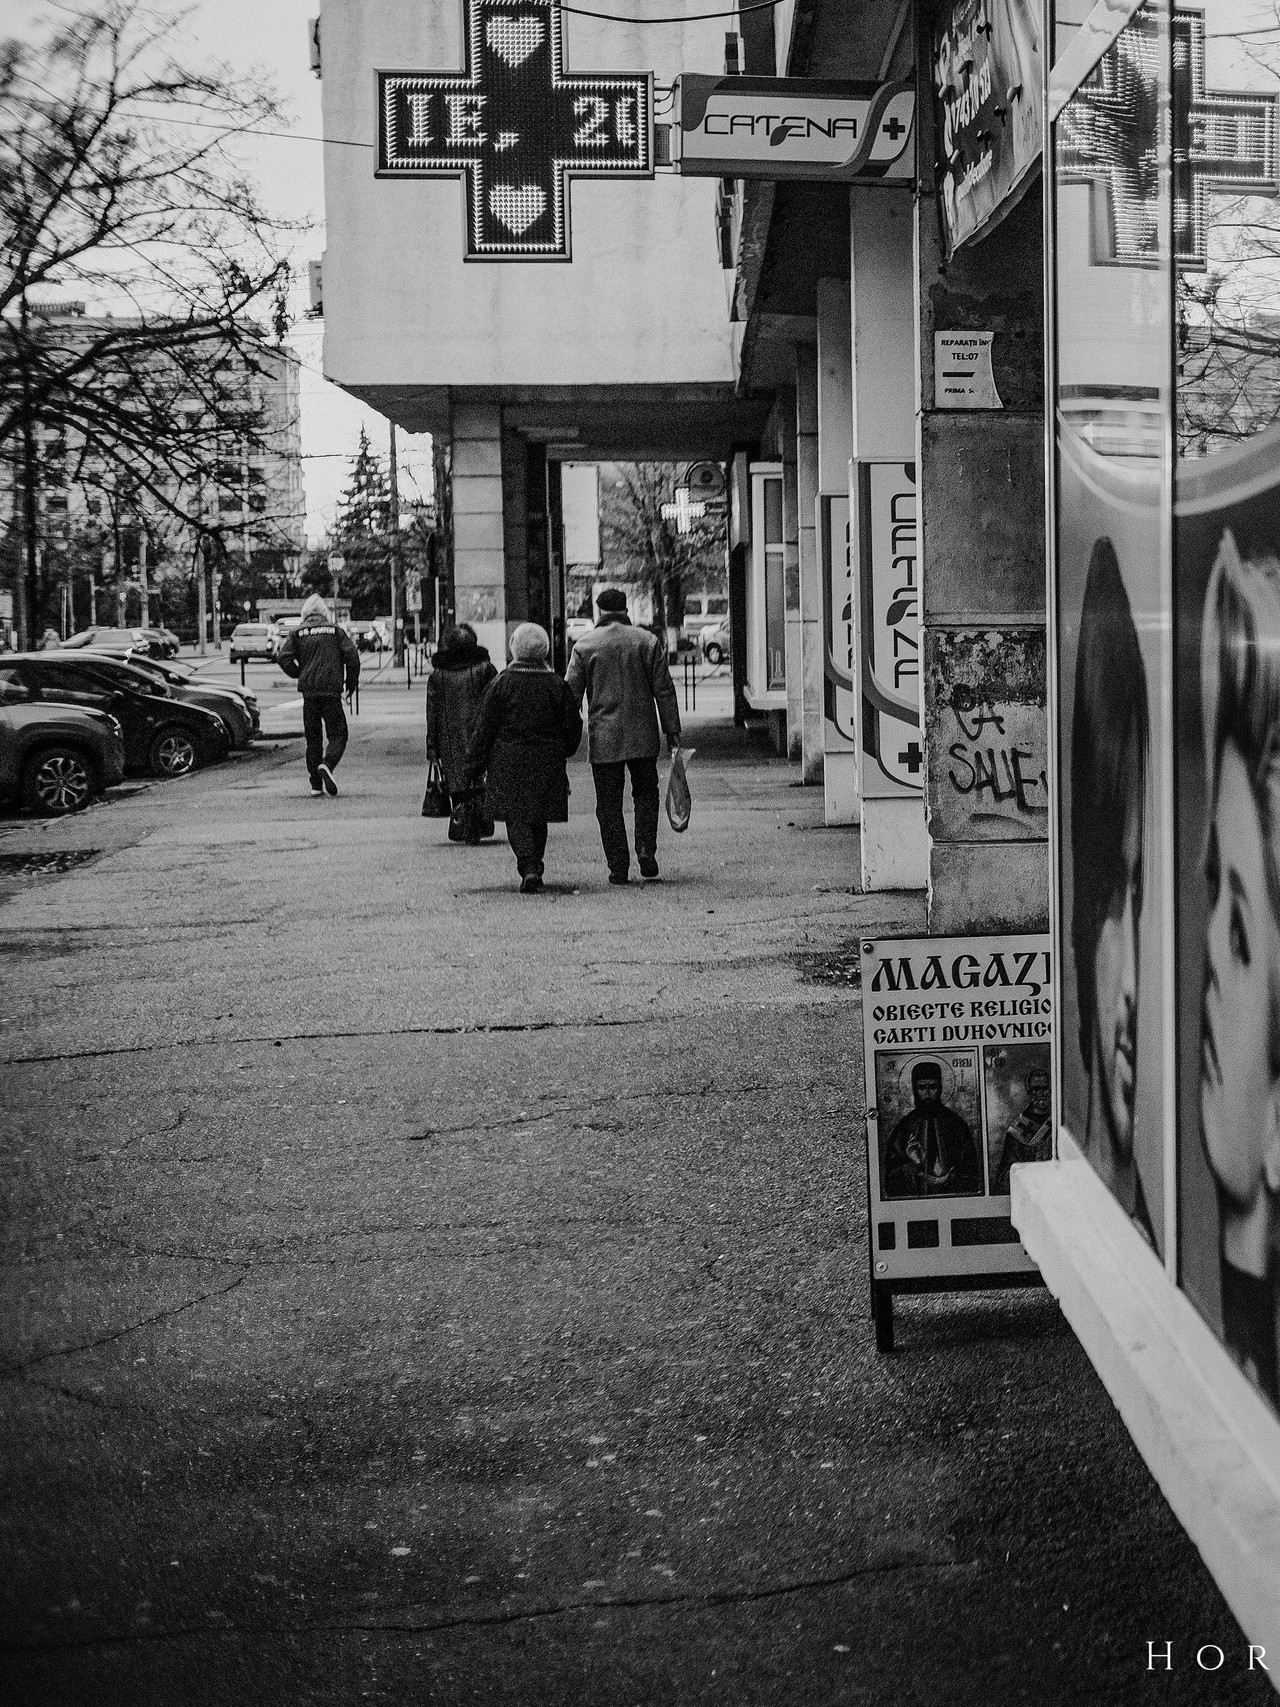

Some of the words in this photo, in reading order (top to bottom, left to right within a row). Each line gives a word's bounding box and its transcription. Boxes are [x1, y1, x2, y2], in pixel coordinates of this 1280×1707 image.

[704, 104, 857, 147] CATENA
[970, 998, 1051, 1017] RELIGIO
[873, 1026, 936, 1044] CARTI
[942, 1021, 1051, 1041] DUHOVNIC
